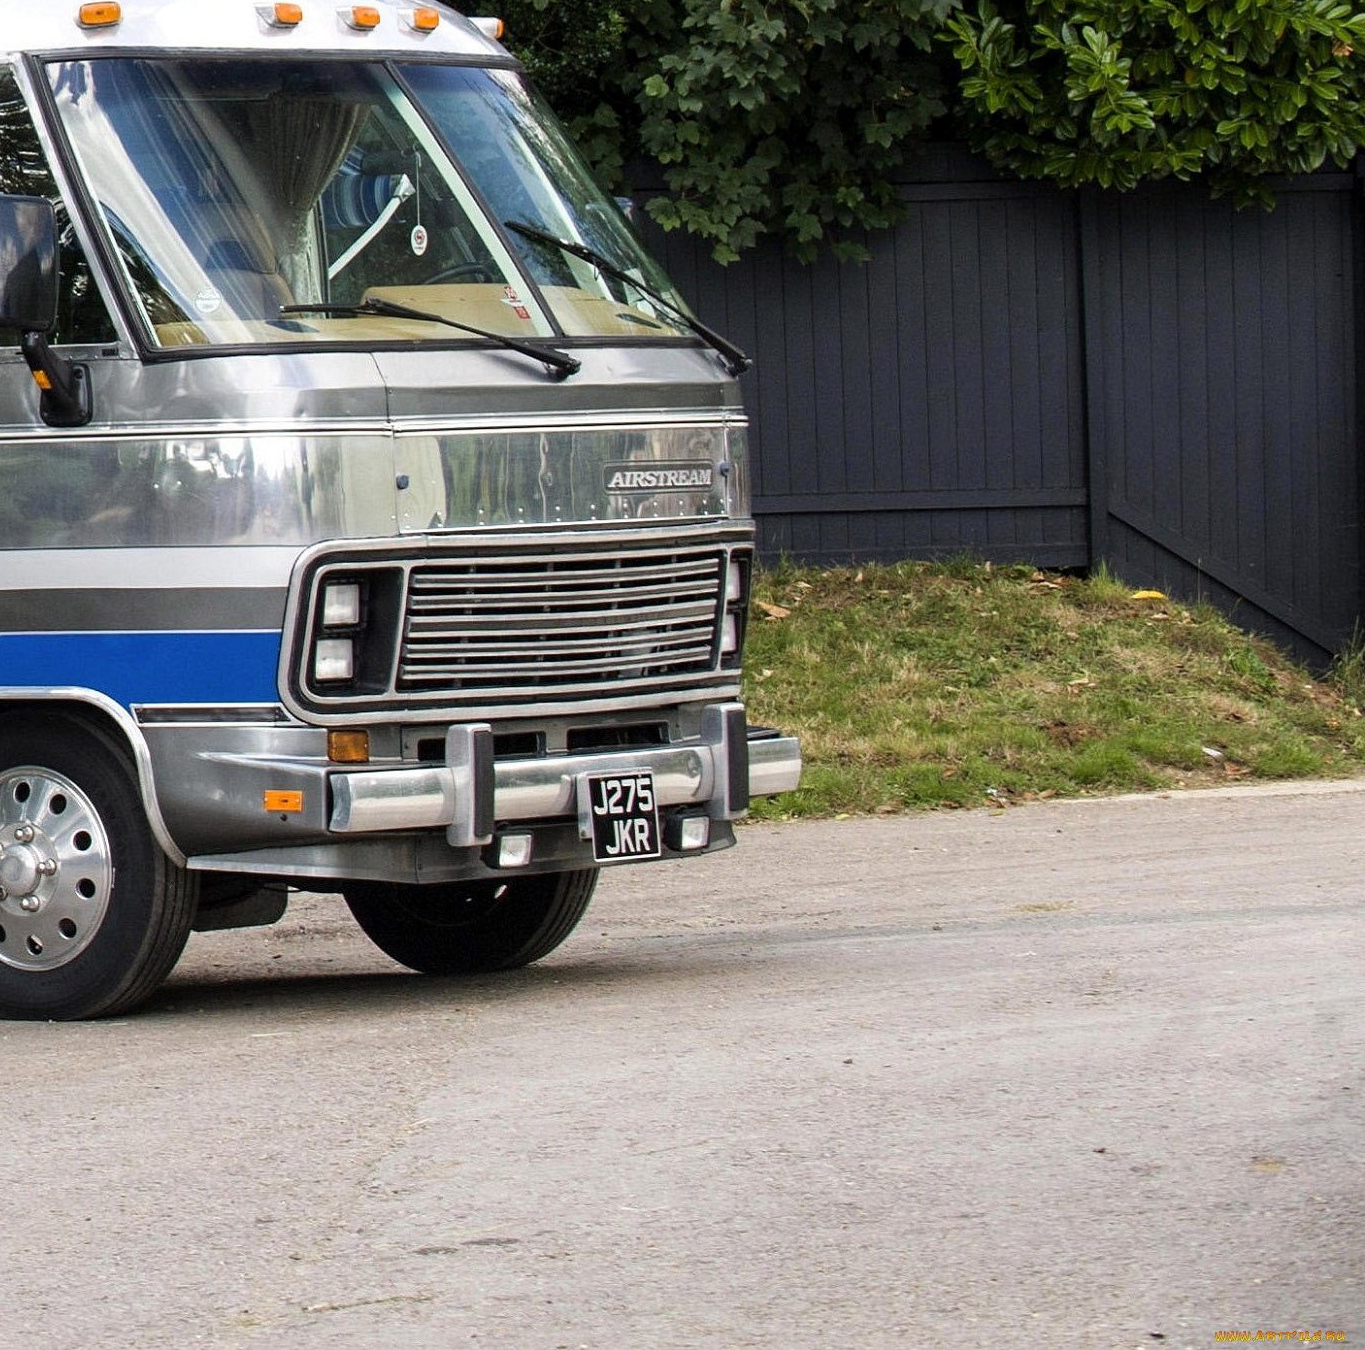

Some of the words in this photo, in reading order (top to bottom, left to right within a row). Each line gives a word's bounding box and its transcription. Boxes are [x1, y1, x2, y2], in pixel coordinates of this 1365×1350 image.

[608, 469, 711, 488] AIRSTREAM
[593, 777, 653, 815] J275
[605, 818, 651, 855] JKR
